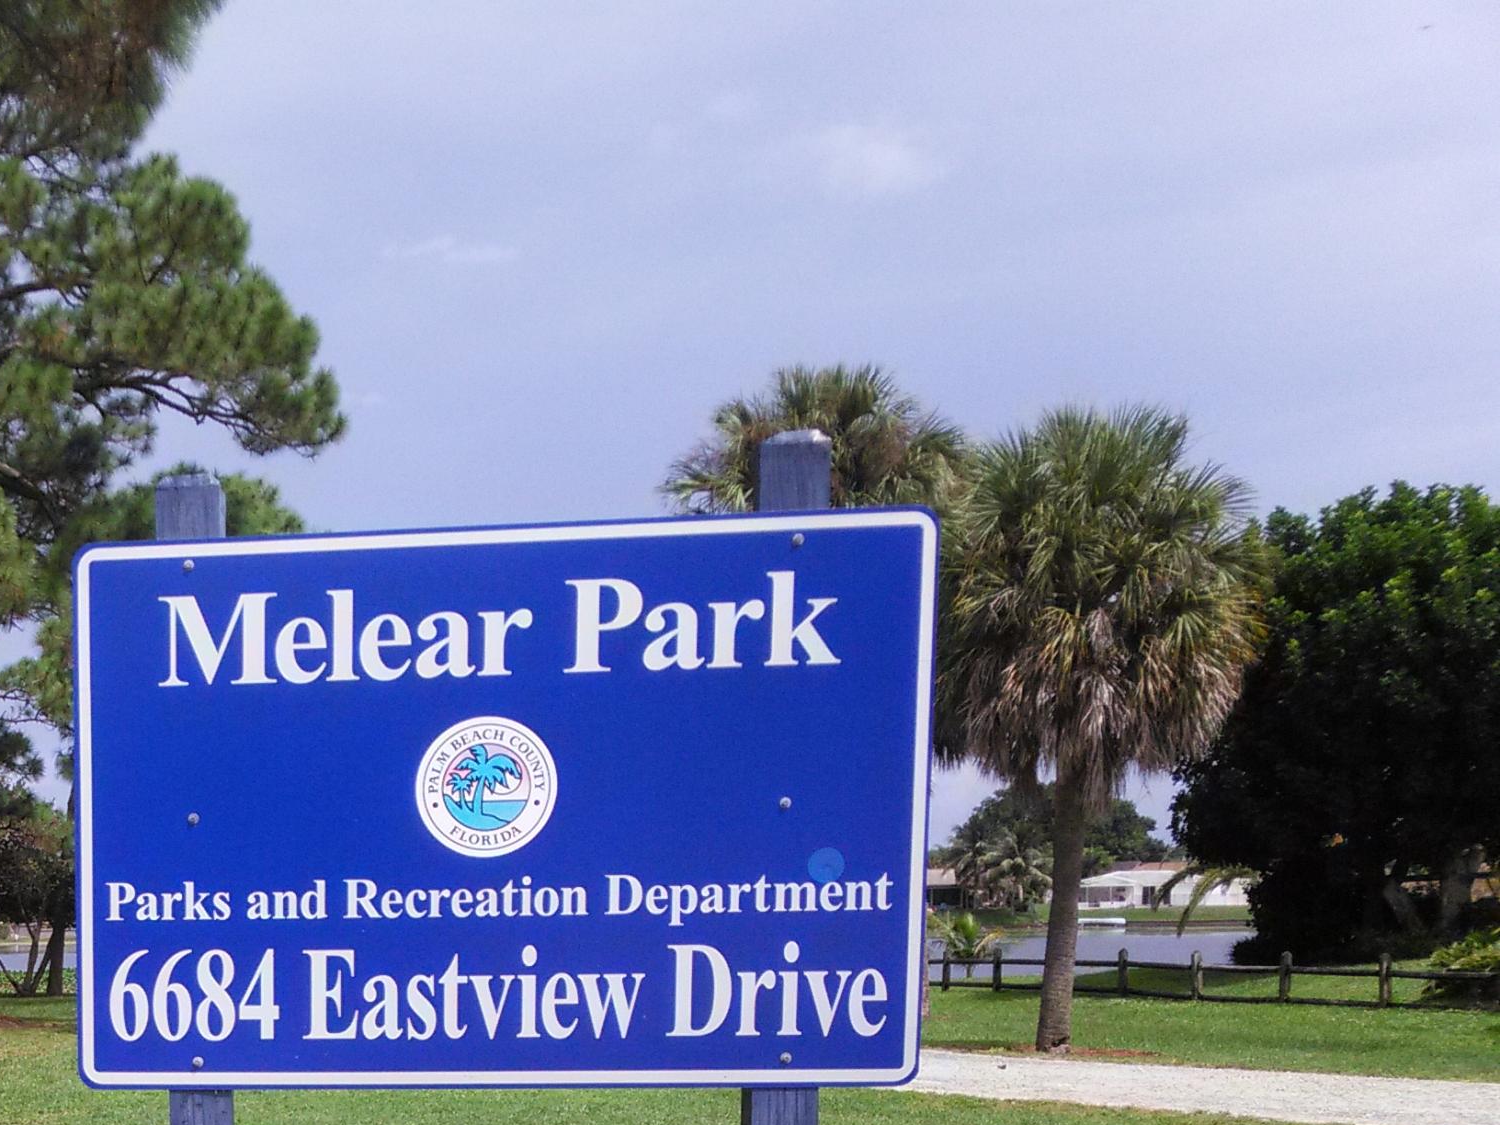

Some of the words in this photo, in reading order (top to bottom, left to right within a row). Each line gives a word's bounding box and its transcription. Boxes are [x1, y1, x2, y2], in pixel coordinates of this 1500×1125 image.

[158, 589, 533, 687] Melear
[563, 570, 842, 674] Park
[428, 751, 451, 793] PALM
[450, 729, 505, 751] BEACH
[509, 735, 545, 791] COUNTY
[450, 825, 522, 846] FLORIDA
[105, 881, 231, 922] Parks
[247, 877, 327, 920] and
[342, 875, 588, 920] Recreation
[604, 871, 894, 927] Department
[109, 947, 281, 1042] 6684
[302, 943, 645, 1041] Eastview
[666, 940, 889, 1038] Drive
